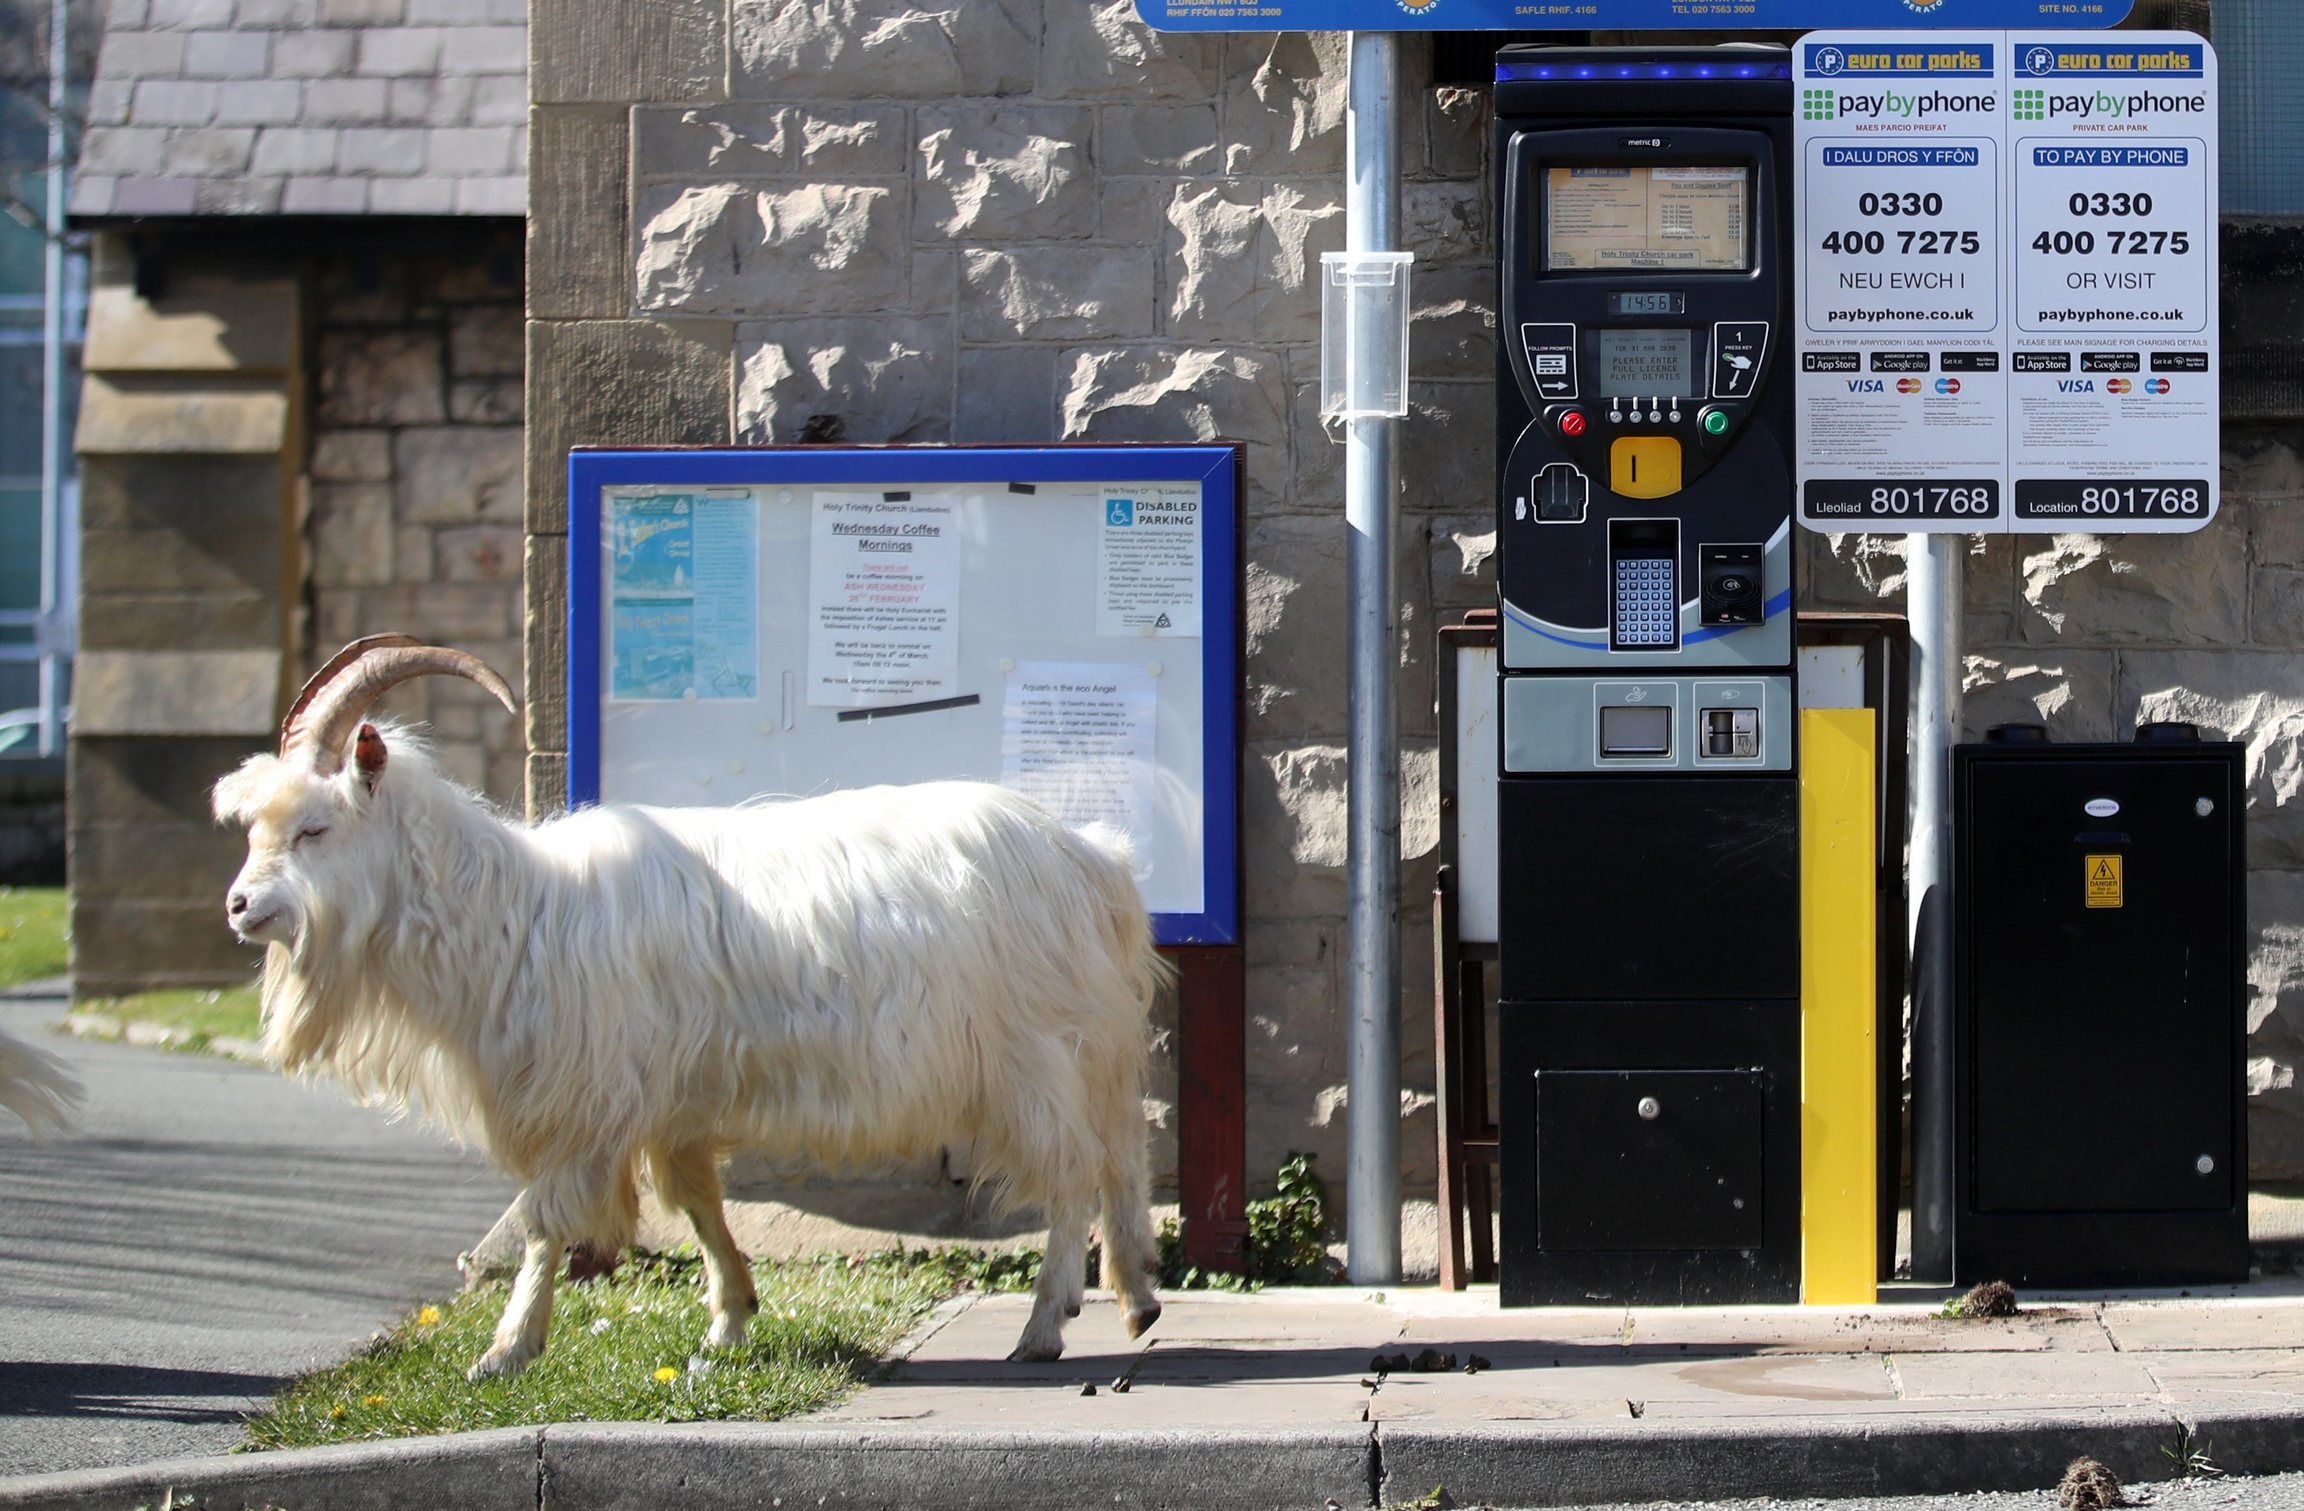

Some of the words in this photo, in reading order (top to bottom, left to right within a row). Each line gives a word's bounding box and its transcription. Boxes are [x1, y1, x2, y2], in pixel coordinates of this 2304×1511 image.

[1219, 8, 1234, 16] 020
[1237, 8, 1258, 16] 7563
[1260, 8, 1281, 16] 3000
[1395, 0, 1440, 15] PERATO
[1515, 6, 1546, 14] SAFLE
[1549, 6, 1573, 14] RHIF.
[1576, 6, 1597, 14] 4166
[1672, 5, 1689, 13] TEL
[1692, 5, 1708, 13] 020
[1711, 5, 1731, 13] 7563
[1734, 5, 1755, 13] 3000
[2039, 5, 2060, 13] SITE
[2063, 4, 2079, 13] NO.
[2082, 5, 2103, 13] 4166
[1848, 54, 1891, 69] euro
[1896, 54, 1924, 69] car
[1928, 51, 1981, 72] parks
[2058, 54, 2101, 69] euro
[2106, 54, 2133, 69] car
[2138, 51, 2190, 72] parks
[1839, 90, 1996, 118] paybyphone
[2050, 90, 2205, 118] paybyphone
[2073, 124, 2105, 132] PRIVATE
[2108, 124, 2125, 132] CAR
[2127, 124, 2148, 132] PARK
[1826, 151, 1830, 163] I
[1834, 151, 1872, 163] DALU
[1877, 151, 1918, 163] DROS
[1920, 151, 1931, 163] Y
[1936, 148, 1975, 163] FFÔN
[2037, 151, 2059, 163] TO
[2064, 151, 2096, 163] PAY
[2101, 151, 2120, 163] BY
[2127, 151, 2184, 163] PHONE
[1859, 192, 1943, 216] 0330
[2069, 192, 2153, 216] 0330
[1822, 231, 1885, 254] 400
[1897, 231, 1980, 254] 7275
[2032, 231, 2095, 254] 400
[2107, 231, 2189, 254] 7275
[1839, 272, 1883, 289] NEU
[1890, 272, 1953, 289] EWCH
[1960, 272, 1964, 289] I
[2066, 272, 2097, 289] OR
[2104, 272, 2156, 289] VISIT
[1627, 295, 1667, 310] 14:56
[1828, 308, 1974, 322] paybyphone.co.uk
[2038, 308, 2184, 322] paybyphone.co.uk
[1736, 332, 1742, 342] 1
[1817, 360, 1835, 371] App
[1835, 360, 1857, 369] Store
[1883, 360, 1911, 371] Google
[1912, 361, 1928, 370] play
[2027, 360, 2045, 371] App
[2045, 360, 2067, 369] Store
[2093, 360, 2121, 371] Google
[2122, 361, 2138, 370] play
[1846, 379, 1885, 392] VISA
[2056, 379, 2094, 392] VISA
[1135, 502, 1198, 512] DISABLED
[1816, 502, 1862, 513] Lleoliad
[1870, 487, 1989, 514] 801768
[2030, 502, 2078, 513] Location
[2081, 487, 2199, 514] 801768
[823, 503, 842, 513] Holy
[845, 503, 873, 514] Trinity
[875, 504, 907, 513] Church
[1139, 515, 1194, 526] PARKING
[832, 523, 899, 536] Wednesday
[902, 524, 940, 536] Coffee
[858, 539, 913, 551] Mornings
[1060, 684, 1073, 693] the
[1092, 684, 1116, 694] Angel
